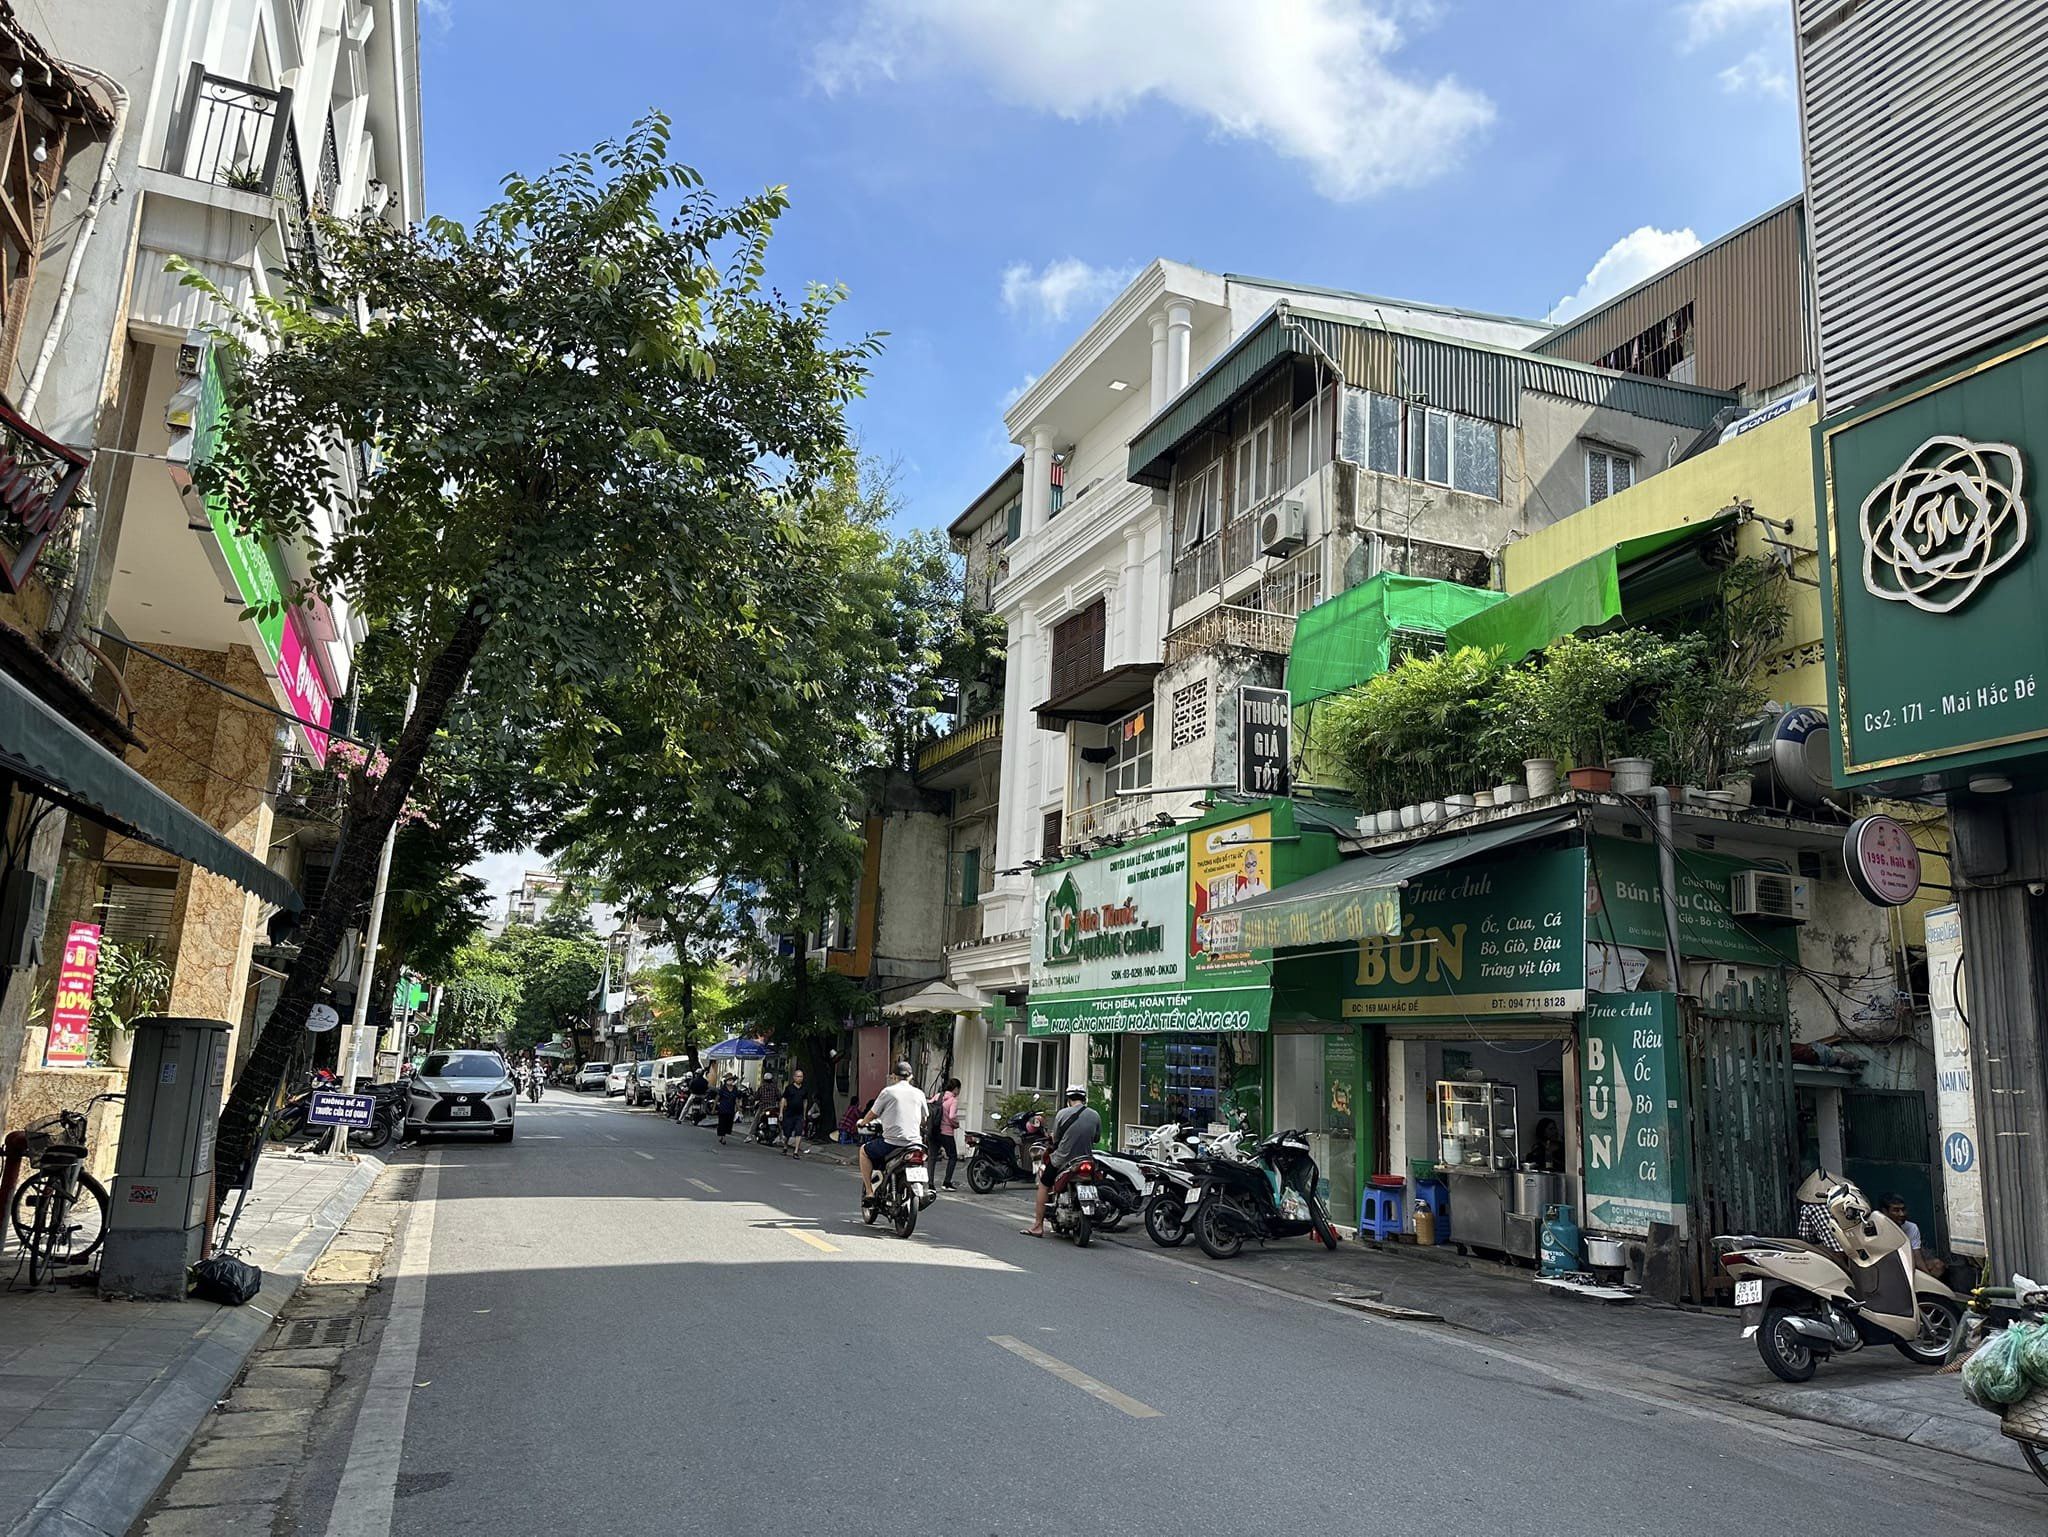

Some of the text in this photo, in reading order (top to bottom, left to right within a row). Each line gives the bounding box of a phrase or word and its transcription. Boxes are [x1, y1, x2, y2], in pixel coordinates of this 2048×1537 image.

[1243, 695, 1288, 728] THUỐC
[1864, 710, 1898, 732] Cs2:
[1902, 702, 1923, 724] 171
[1942, 691, 1971, 716] Mai
[1977, 683, 2008, 705] Hắc
[2014, 674, 2036, 698] Đế
[1254, 729, 1279, 758] GIÁ
[1253, 758, 1280, 791] TỐT
[1126, 856, 1135, 868] BÁN
[1142, 848, 1155, 864] THUỐC
[1155, 847, 1171, 860] THÀNH
[1137, 867, 1150, 883] THUỐC
[1616, 879, 1649, 903] Bún
[1078, 896, 1138, 932] Nhà Thuốc
[1481, 912, 1562, 934] Ốc, Cua, Cá
[1700, 916, 1711, 927] Bò
[1290, 912, 1311, 944] CUA
[1355, 913, 1468, 986] BÚN
[1481, 936, 1562, 956] Bò, Giò, Đậu
[1481, 959, 1561, 978] Trứng vịt lộn
[58, 991, 91, 1010] 10%
[1139, 995, 1165, 1007] HOÀN
[1365, 1004, 1376, 1012] 169
[1378, 1003, 1390, 1011] MAI
[1391, 1000, 1407, 1011] HẮC
[1491, 997, 1566, 1009] ĐT: 094 711 8128
[1588, 1001, 1653, 1017] Trúc Anh
[1072, 1014, 1097, 1032] CÀNG
[1097, 1011, 1127, 1031] NHIỀU
[1127, 1010, 1160, 1031] HOÀN
[1160, 1009, 1185, 1030] TIỀN
[1186, 1008, 1221, 1031] CÀNG
[1221, 1010, 1250, 1029] CAO
[1633, 1030, 1662, 1049] Riêu
[1634, 1054, 1651, 1081] Ốc
[1939, 1071, 1957, 1093] NAM
[321, 1097, 345, 1106] KHÔNG
[1588, 1037, 1613, 1170] BÚN
[1636, 1095, 1653, 1114] Bò
[353, 1109, 368, 1119] QUAN
[1637, 1127, 1659, 1147] Giò
[1949, 1137, 1969, 1167] 169
[1639, 1160, 1657, 1181] Cá
